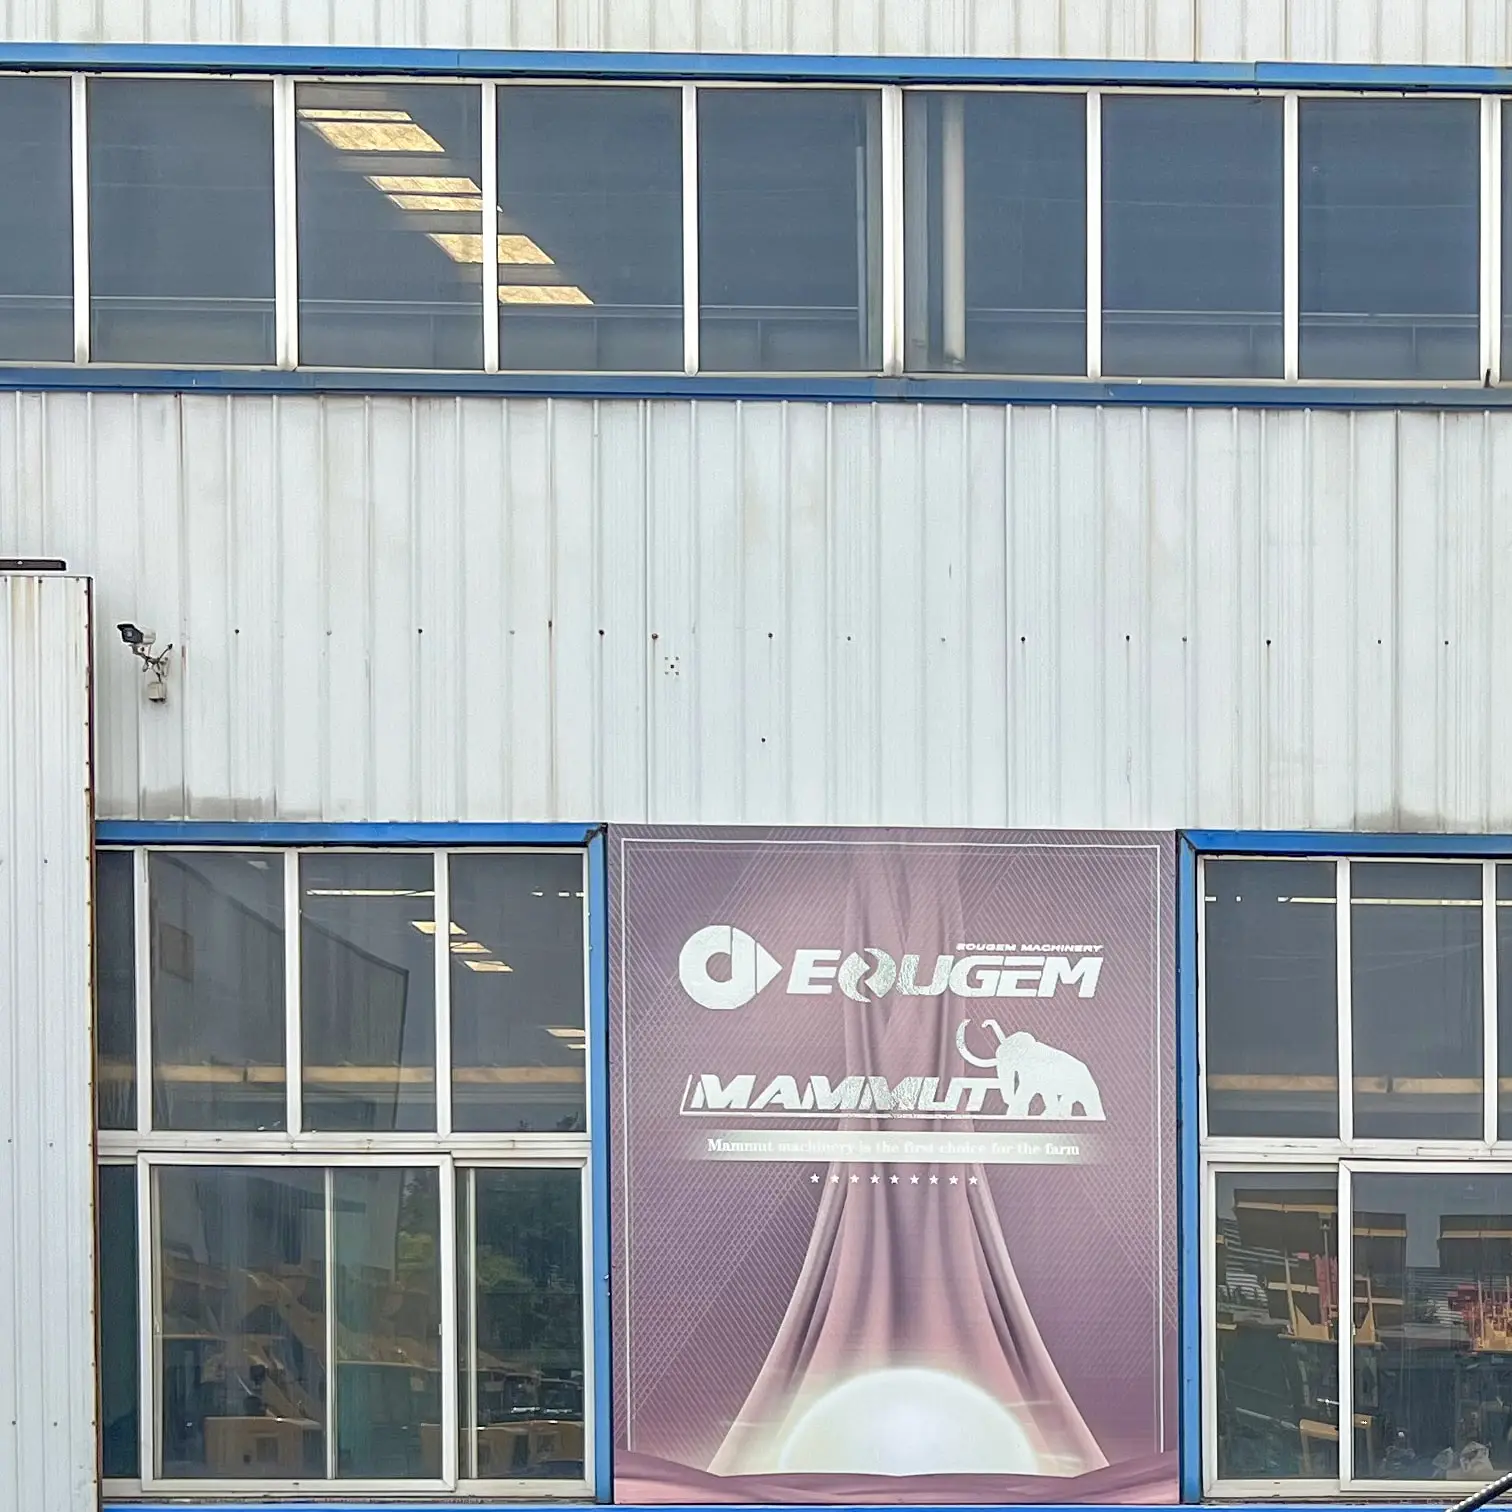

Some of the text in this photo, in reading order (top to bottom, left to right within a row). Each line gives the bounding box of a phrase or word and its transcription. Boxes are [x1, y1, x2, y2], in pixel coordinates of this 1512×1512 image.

[956, 943, 1103, 952] EOUGEM MACHINERY
[690, 1073, 1000, 1112] MAMMUT
[707, 1138, 1080, 1156] Mammut machinery is the first choice for the farm
